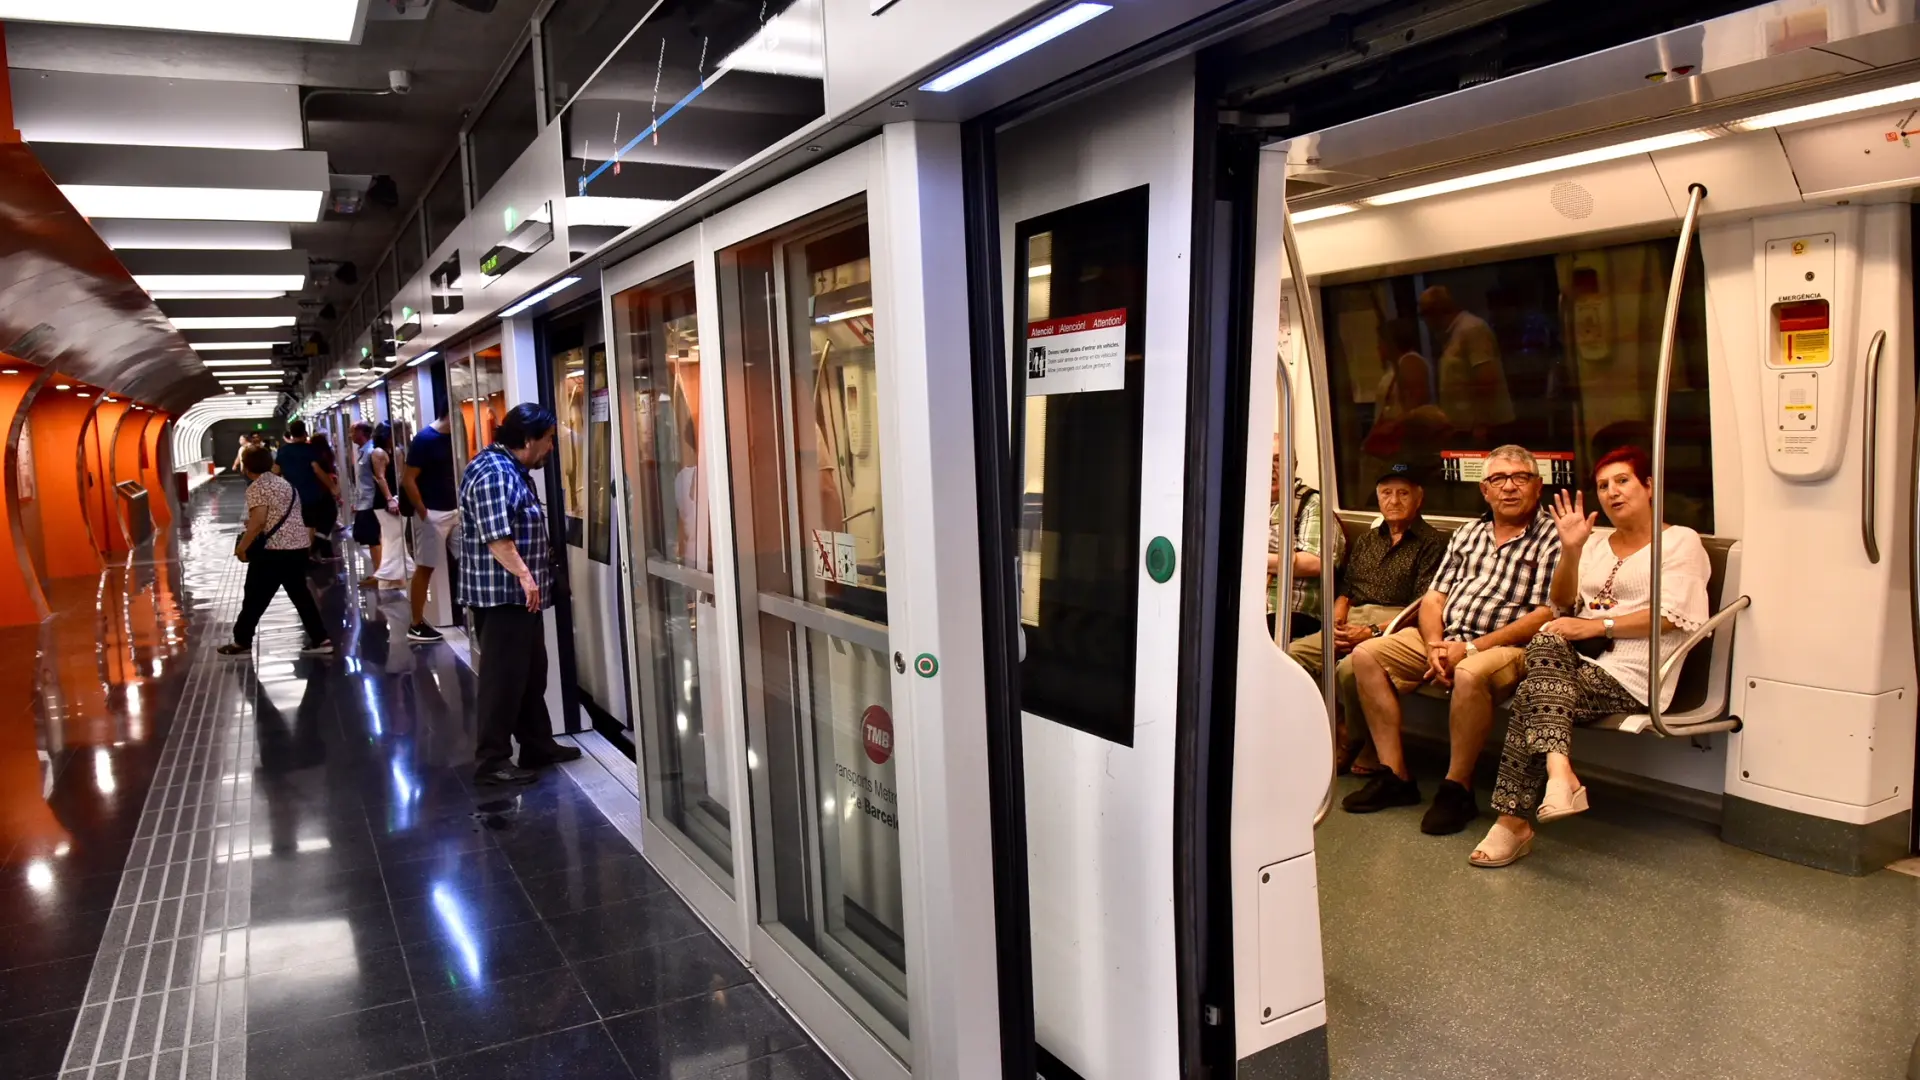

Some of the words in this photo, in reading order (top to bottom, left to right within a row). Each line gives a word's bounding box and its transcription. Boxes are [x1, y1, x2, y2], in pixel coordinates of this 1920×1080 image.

[1031, 326, 1054, 337] Atenció!
[1093, 315, 1122, 328] Attention!
[866, 724, 889, 748] TMB
[836, 763, 873, 793] ransports
